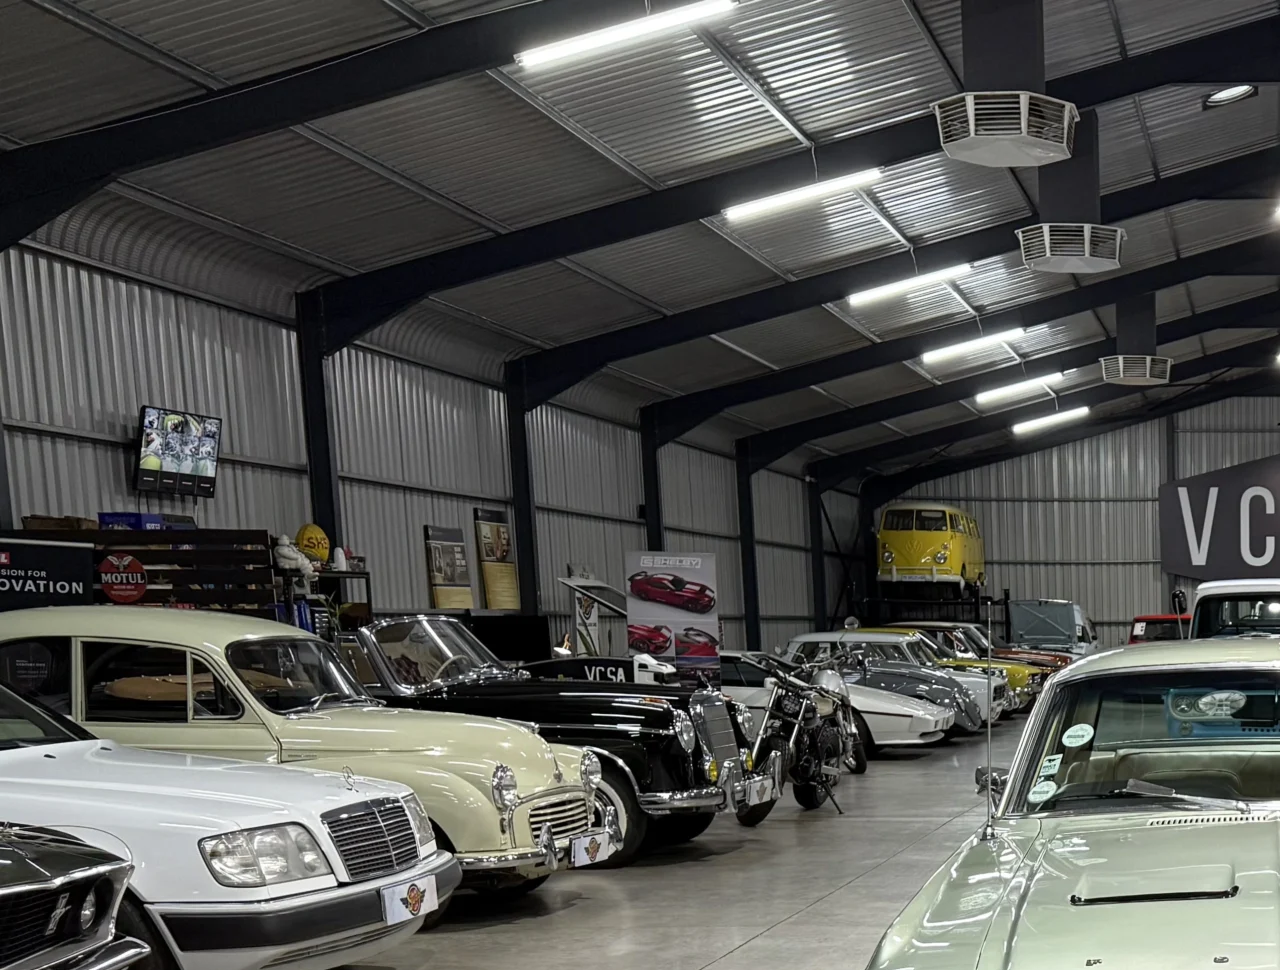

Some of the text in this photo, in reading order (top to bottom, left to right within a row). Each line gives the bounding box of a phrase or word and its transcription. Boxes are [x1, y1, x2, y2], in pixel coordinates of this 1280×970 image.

[28, 570, 47, 578] FOR
[101, 573, 145, 584] MOTUL
[0, 578, 83, 595] OVATION
